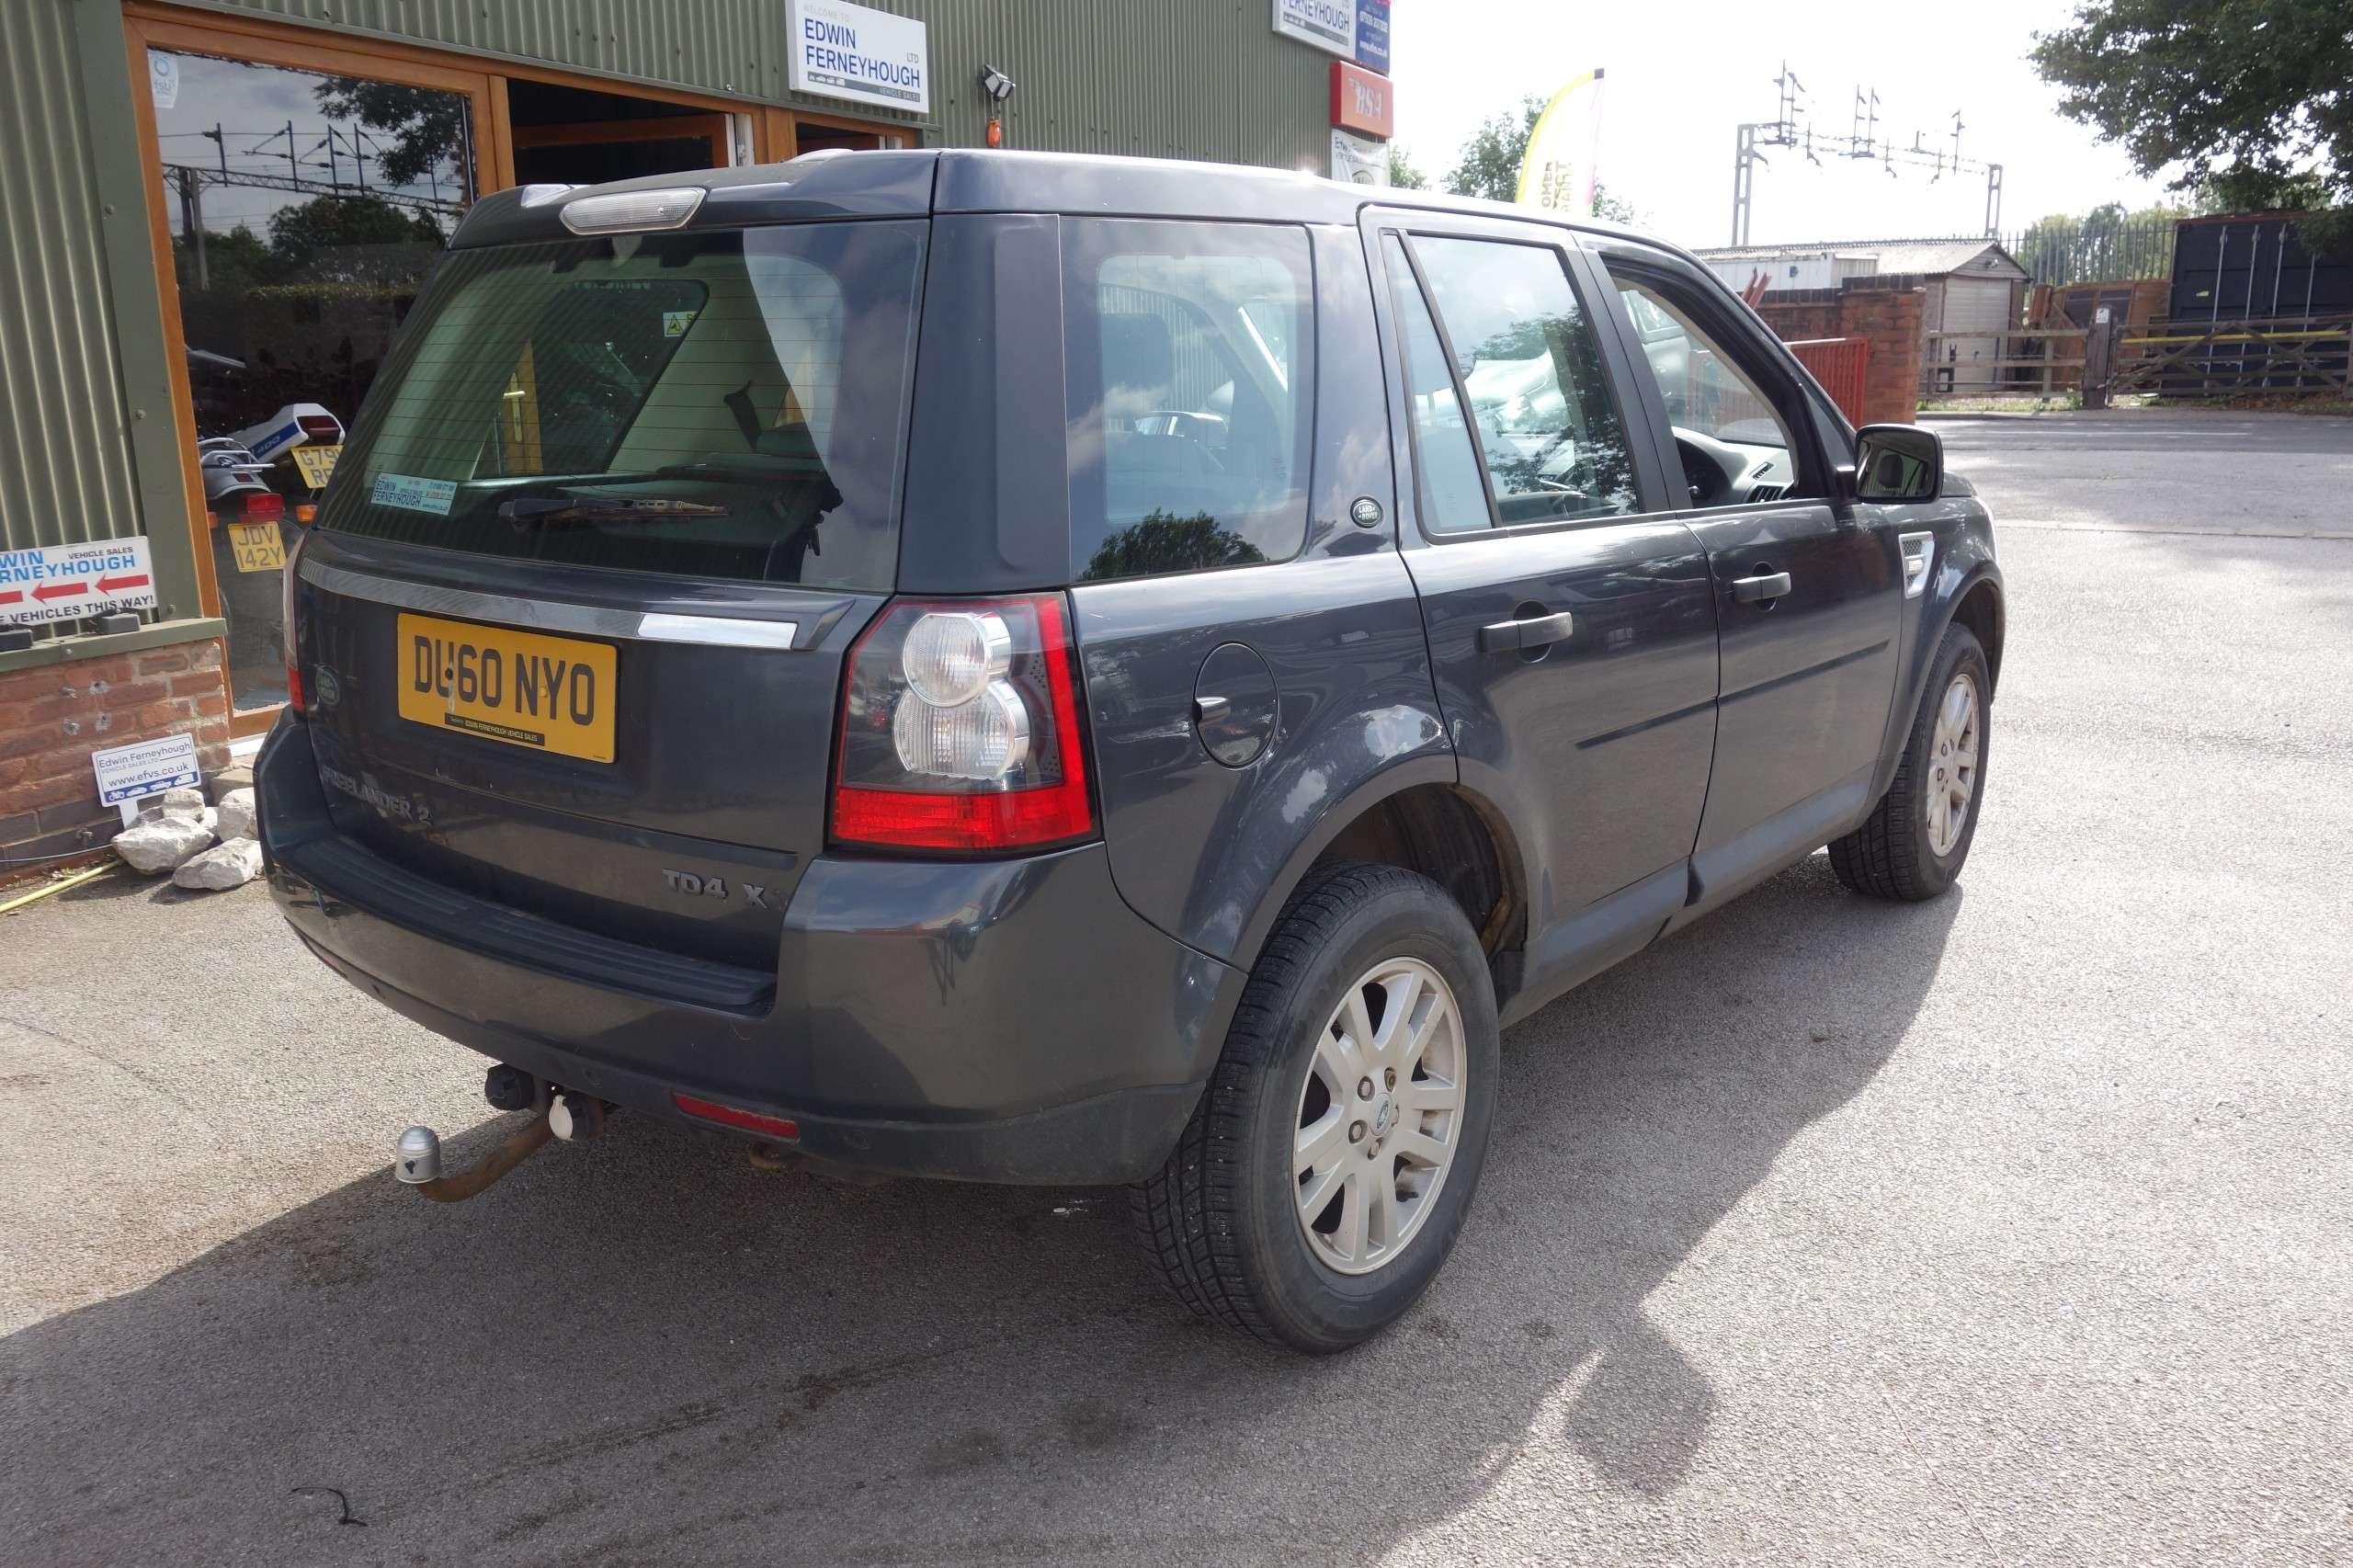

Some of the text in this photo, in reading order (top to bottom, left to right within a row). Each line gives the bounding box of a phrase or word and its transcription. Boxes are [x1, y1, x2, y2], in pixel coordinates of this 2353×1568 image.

[804, 17, 856, 49] EDWIN
[806, 44, 920, 88] FERNEYHOUGH
[906, 51, 919, 64] LTD
[376, 478, 397, 492] EDWIN
[1358, 505, 1373, 513] LAND
[1361, 511, 1378, 520] ROVER
[238, 525, 273, 545] JDV
[68, 546, 133, 560] VEHICLE SALES
[237, 547, 280, 568] 142Y
[9, 605, 82, 623] VEHICLES
[85, 600, 118, 613] THIS
[120, 595, 154, 608] WAY!
[415, 635, 596, 725] DU60 NYO
[98, 742, 191, 768] Edwin Ferneyhough
[108, 763, 189, 787] www.efvs.co.uk
[662, 869, 767, 909] TD4 X
